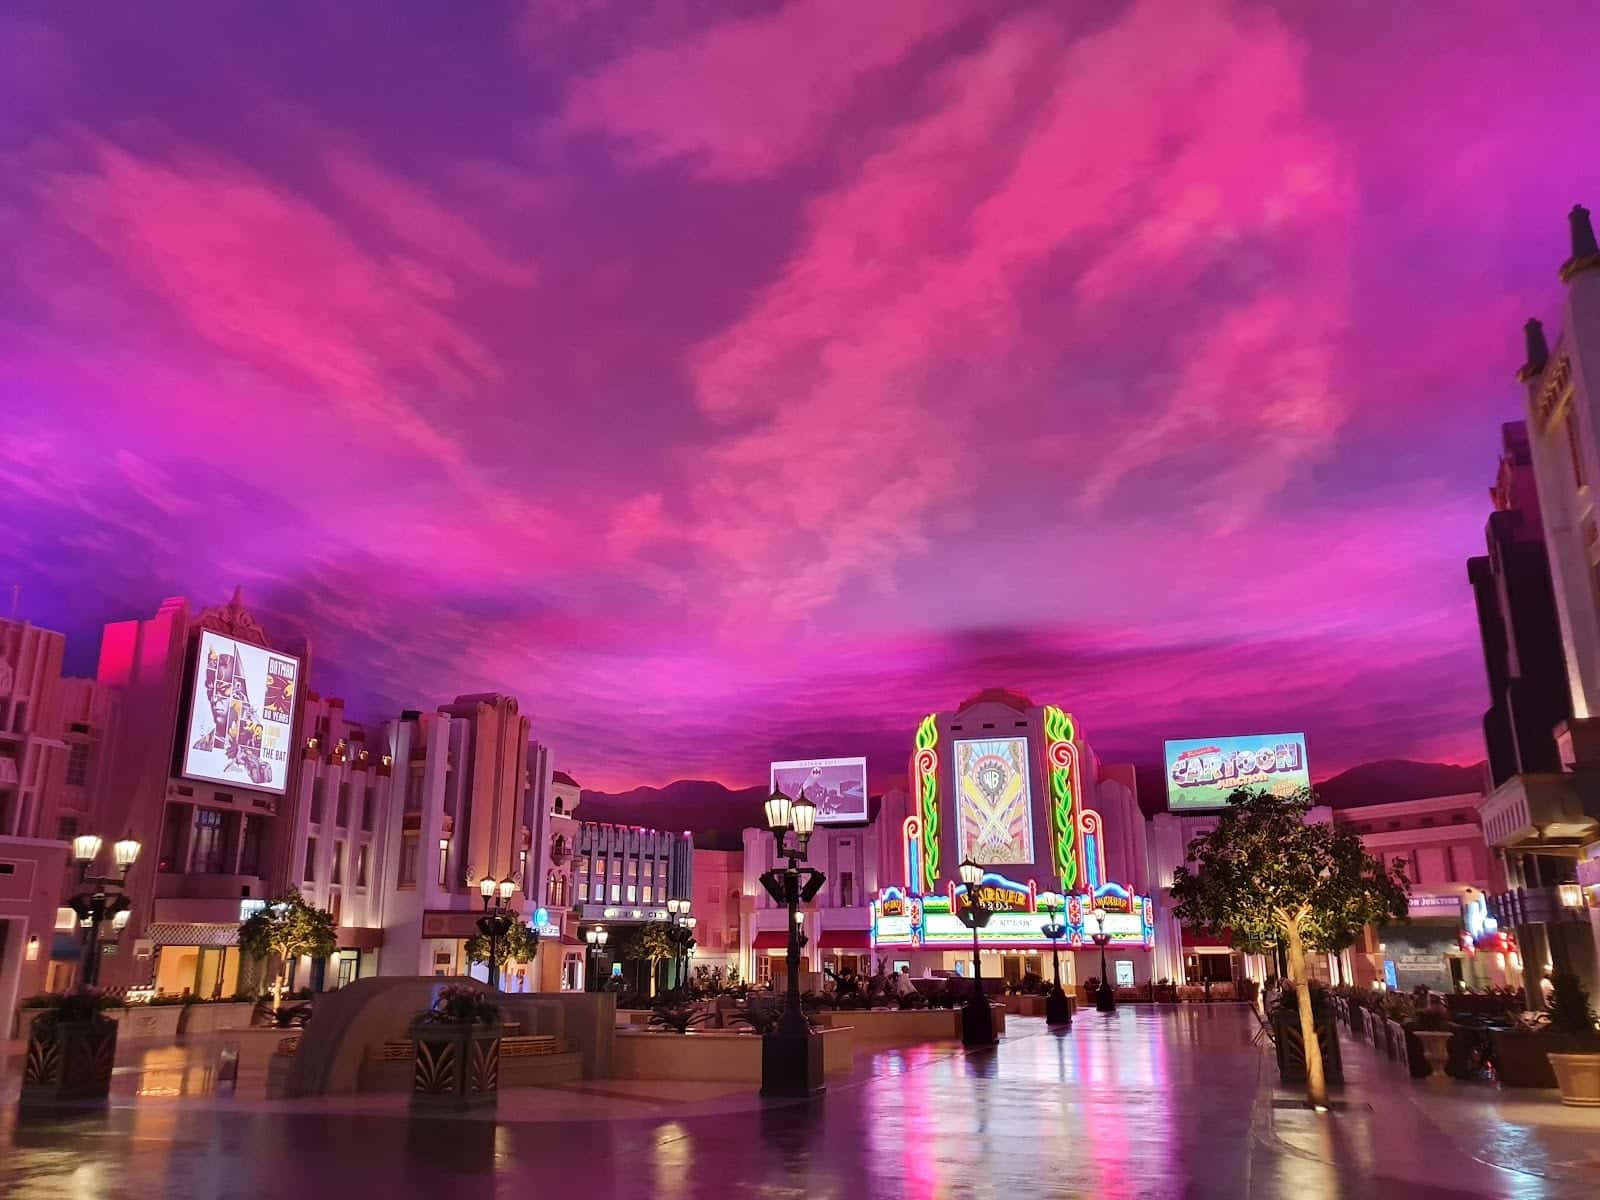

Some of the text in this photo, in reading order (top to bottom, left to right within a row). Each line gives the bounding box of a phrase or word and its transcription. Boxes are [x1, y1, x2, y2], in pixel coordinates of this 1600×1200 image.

[269, 659, 294, 679] BATMAN
[272, 711, 289, 723] YEARS
[262, 747, 287, 762] THE BAT
[1171, 742, 1302, 787] CARTOON
